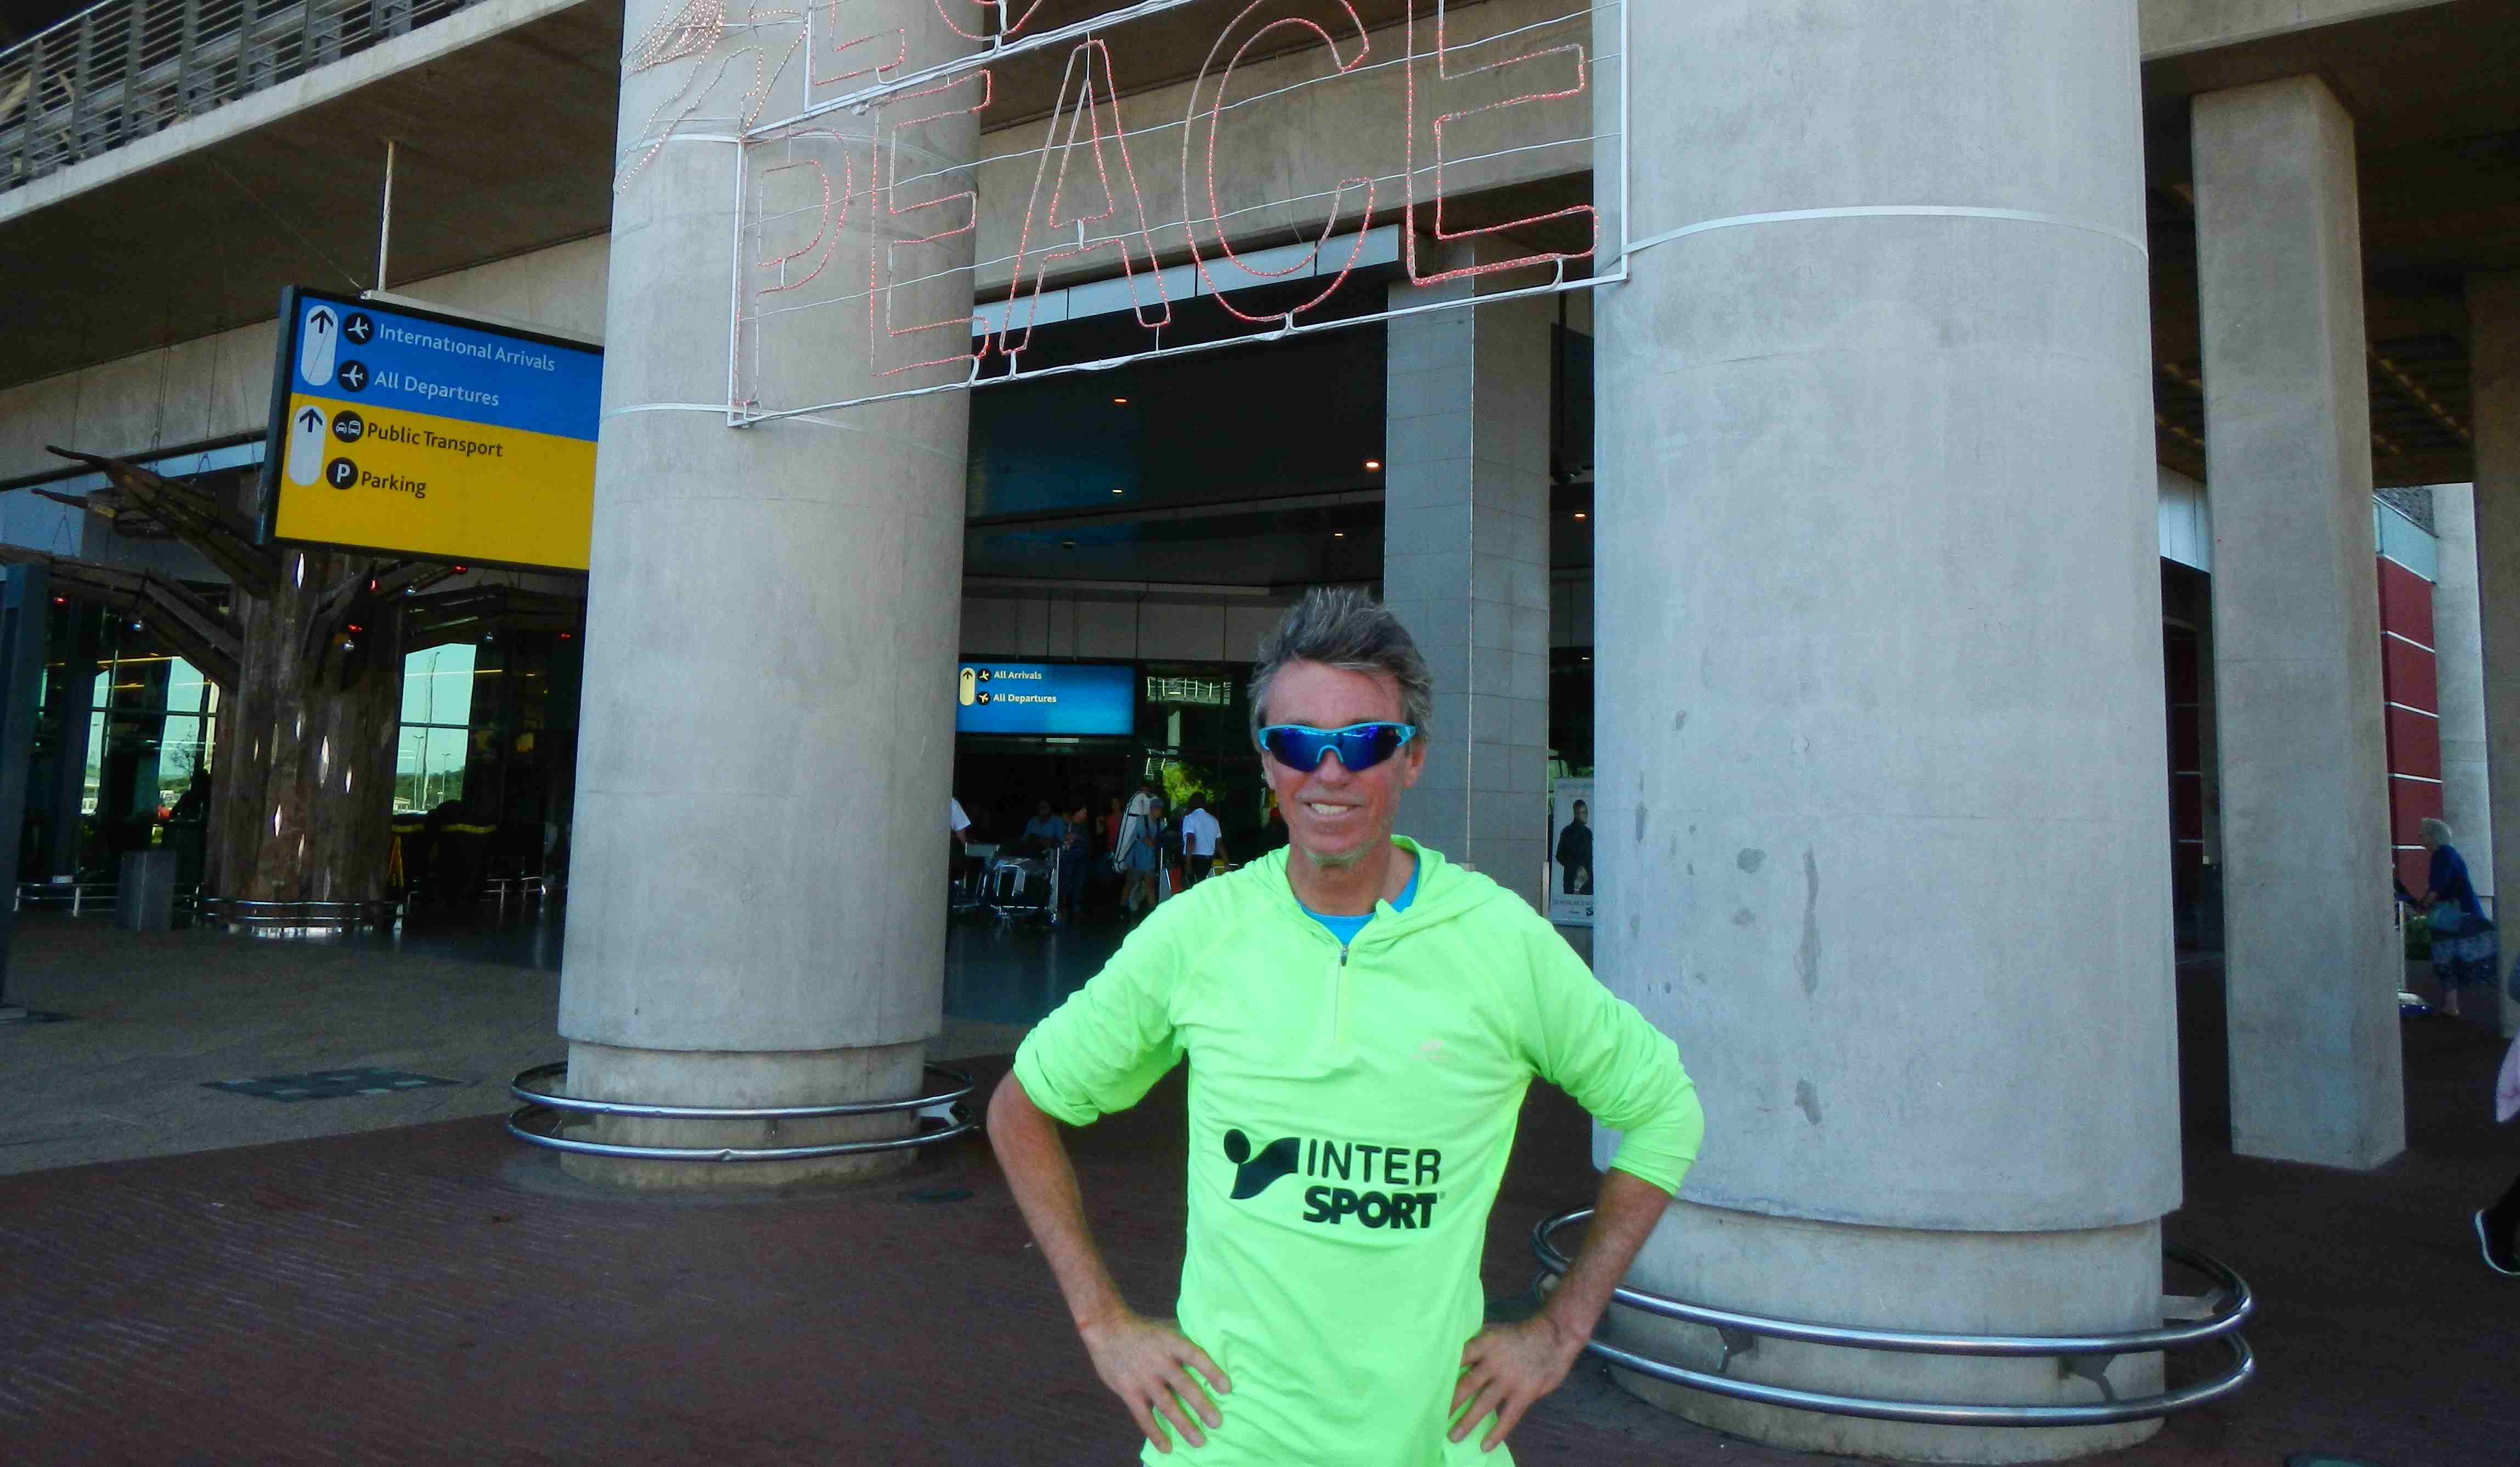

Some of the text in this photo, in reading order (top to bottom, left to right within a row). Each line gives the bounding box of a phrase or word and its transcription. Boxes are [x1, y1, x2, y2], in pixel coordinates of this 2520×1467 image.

[734, 0, 1598, 407] PEACE
[379, 323, 555, 371] International Arrivals
[374, 370, 499, 407] All Departures
[367, 422, 503, 458] Public Transport
[361, 471, 427, 499] Parking
[994, 670, 1042, 680] All Arrivals
[993, 693, 1057, 704] All Departures
[1306, 1138, 1442, 1187] INTER
[1302, 1185, 1438, 1229] SPORT
